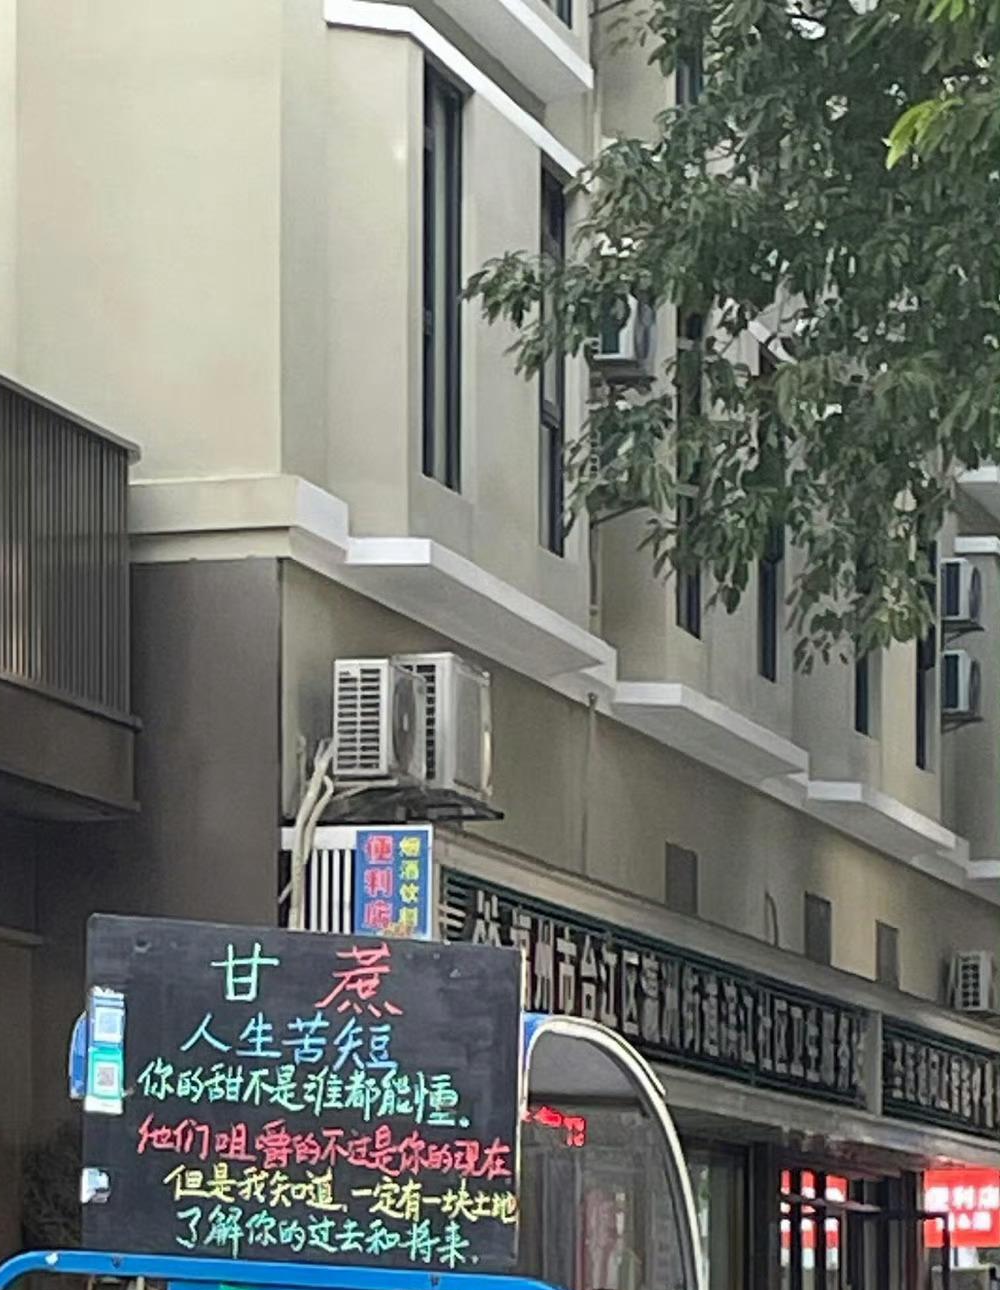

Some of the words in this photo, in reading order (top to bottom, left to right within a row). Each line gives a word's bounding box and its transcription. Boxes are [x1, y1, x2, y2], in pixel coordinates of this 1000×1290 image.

[210, 941, 403, 1018] 甘蔗
[180, 1011, 398, 1071] 人生苦短
